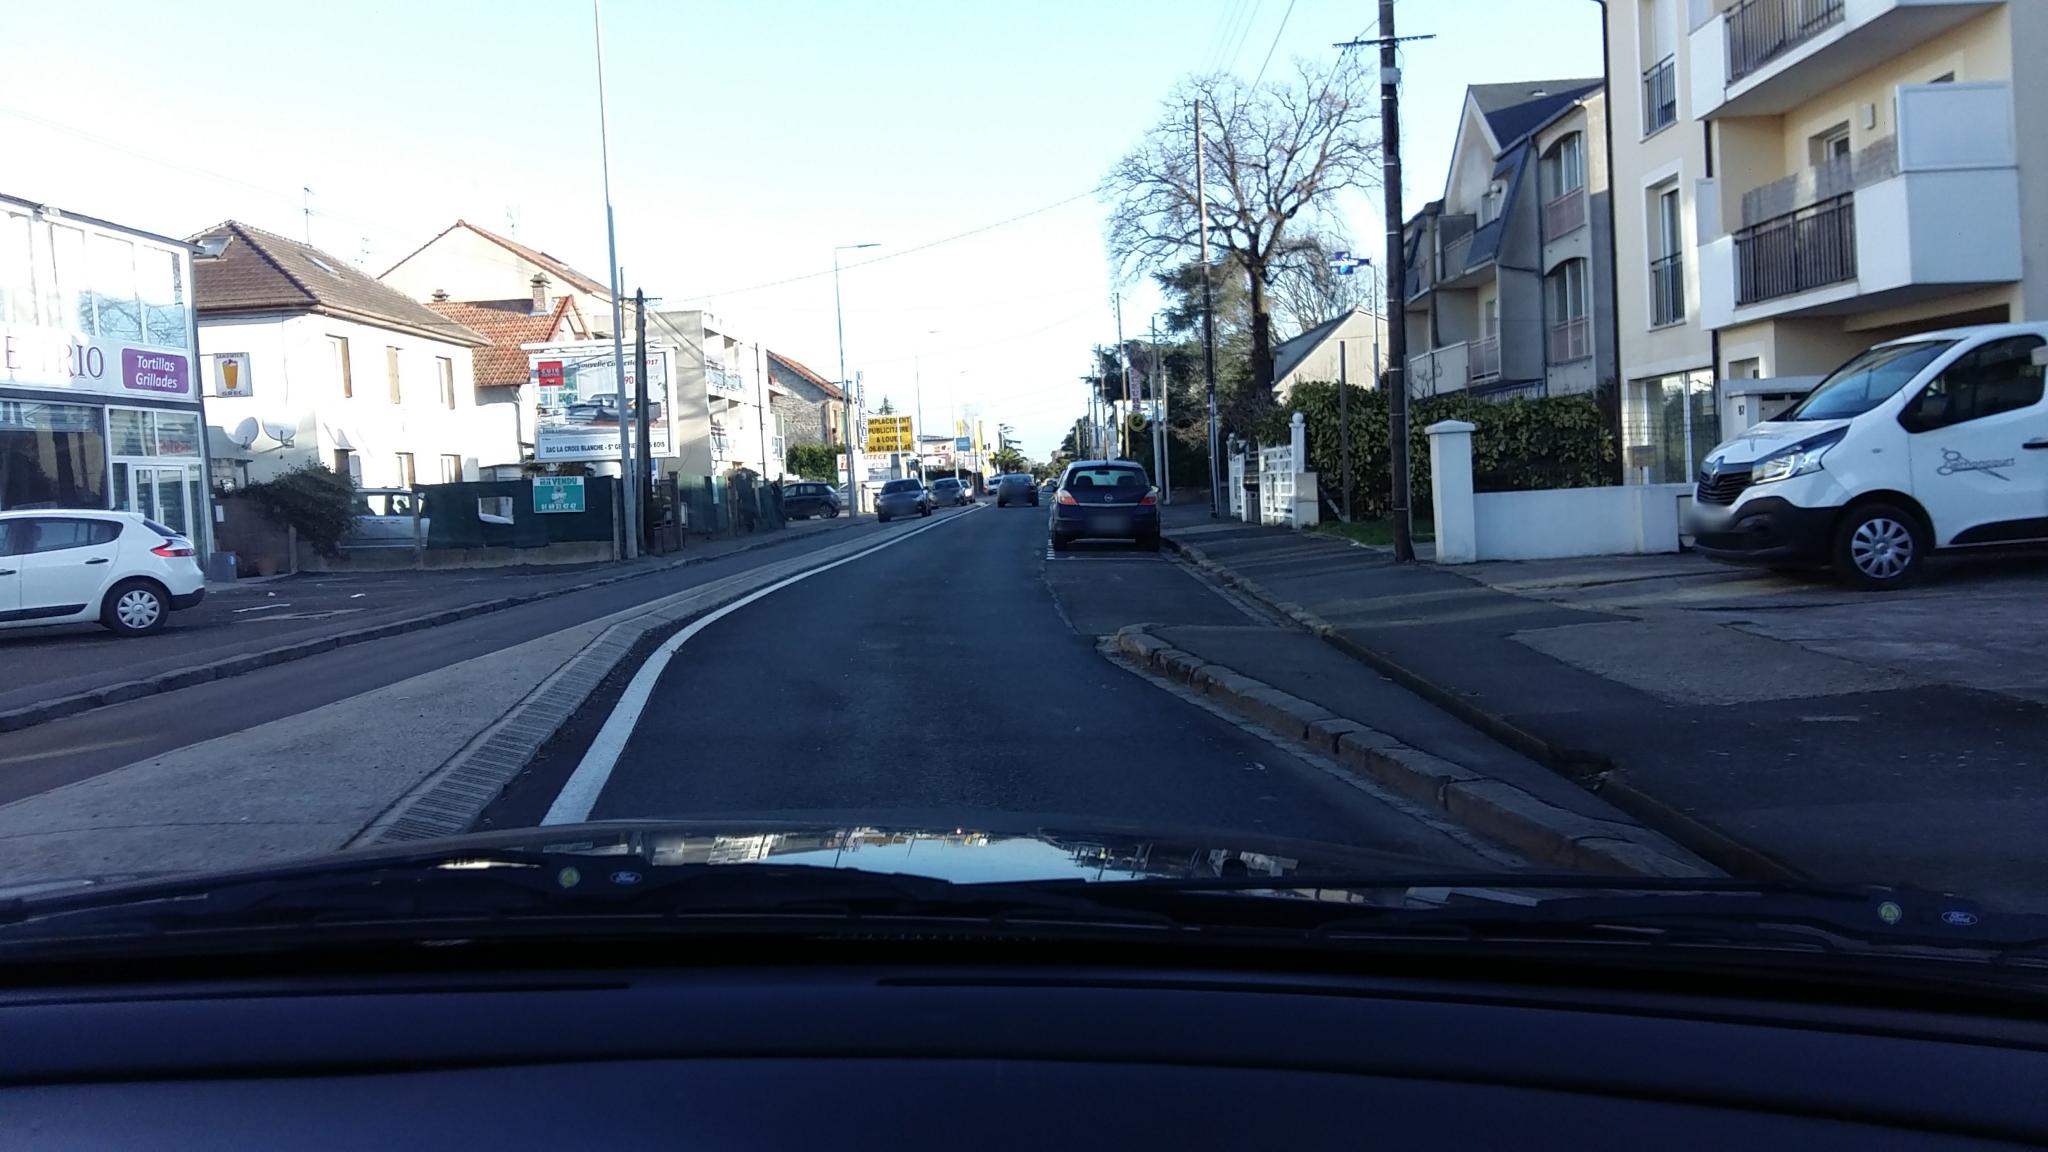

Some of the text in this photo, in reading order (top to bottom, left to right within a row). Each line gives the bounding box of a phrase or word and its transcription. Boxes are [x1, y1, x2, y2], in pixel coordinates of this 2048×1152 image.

[137, 355, 175, 372] Tortillas
[136, 372, 178, 389] Grillades
[581, 444, 603, 452] BLANCHE
